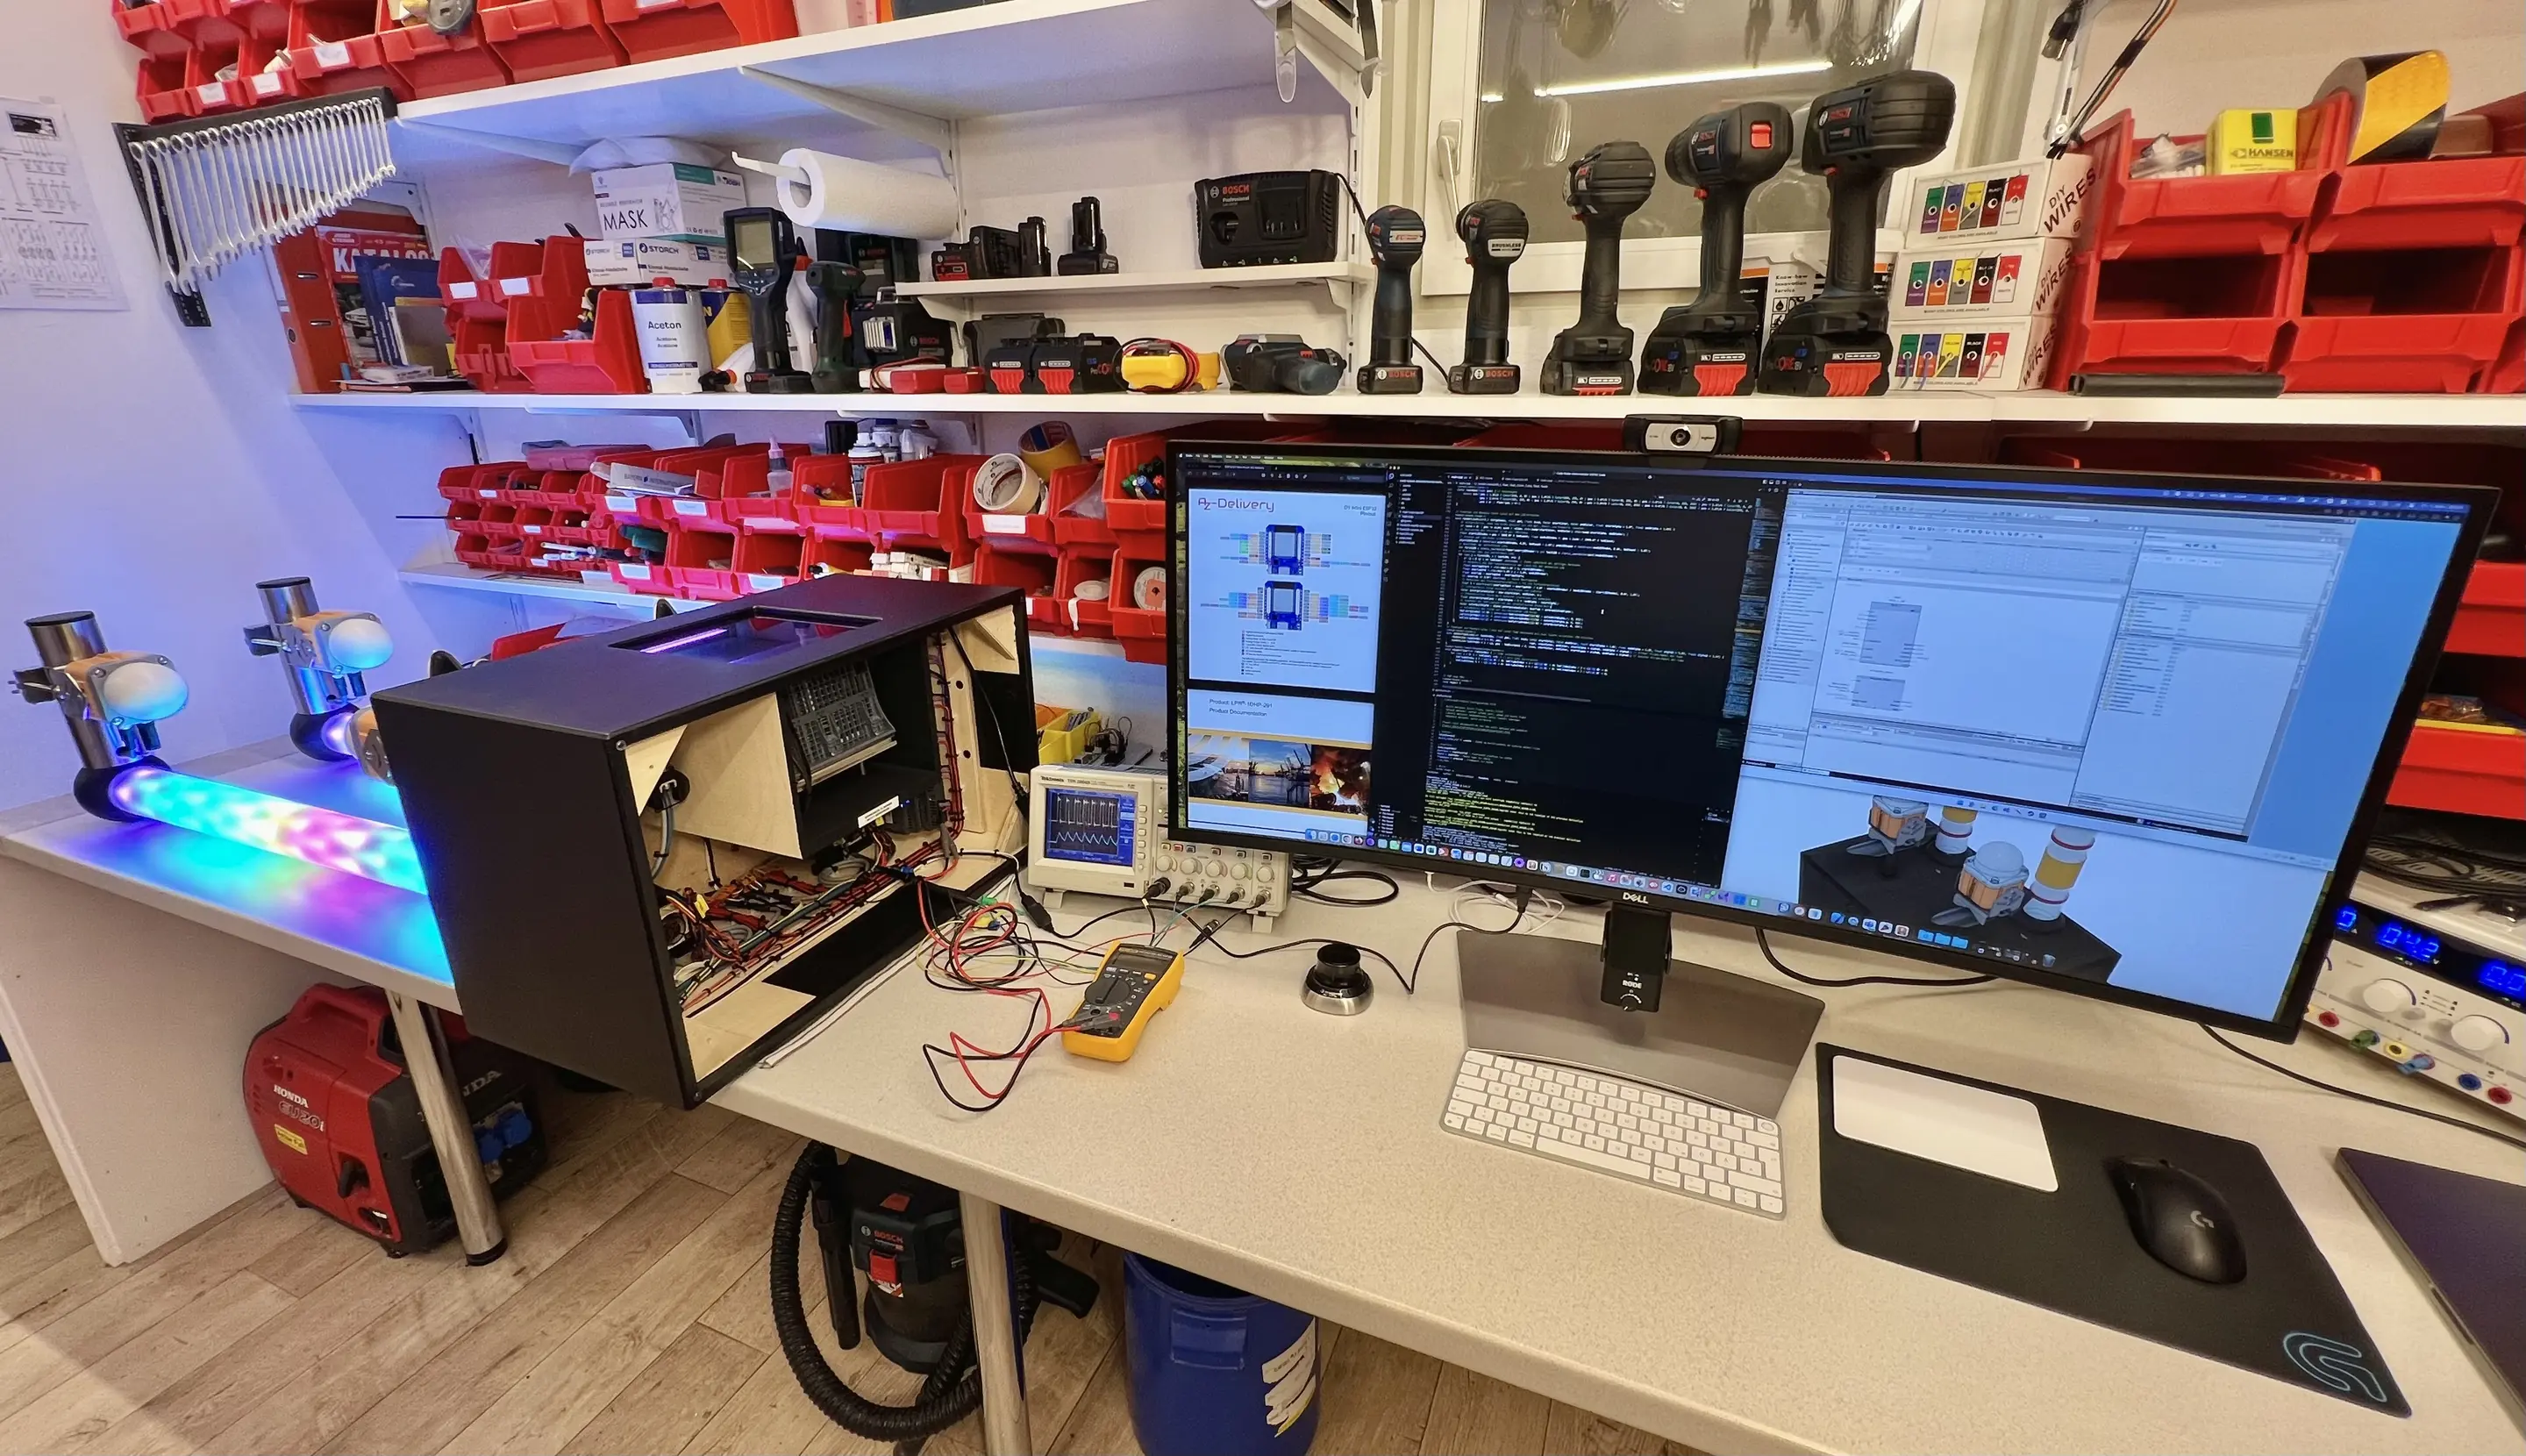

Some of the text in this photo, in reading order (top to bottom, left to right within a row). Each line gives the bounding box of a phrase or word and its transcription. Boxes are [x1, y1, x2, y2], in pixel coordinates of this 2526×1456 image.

[2248, 147, 2294, 157] HANSEN
[1222, 184, 1250, 195] BOSCH
[2044, 167, 2096, 233] WIRES
[2049, 183, 2067, 209] DIY
[603, 209, 648, 231] MASK
[648, 245, 680, 254] STORCH
[648, 321, 681, 330] Aceton
[1485, 369, 1514, 378] BOSCH
[1623, 892, 1649, 904] DELL
[274, 1084, 310, 1109] HONDA
[874, 1230, 903, 1244] BOSCH
